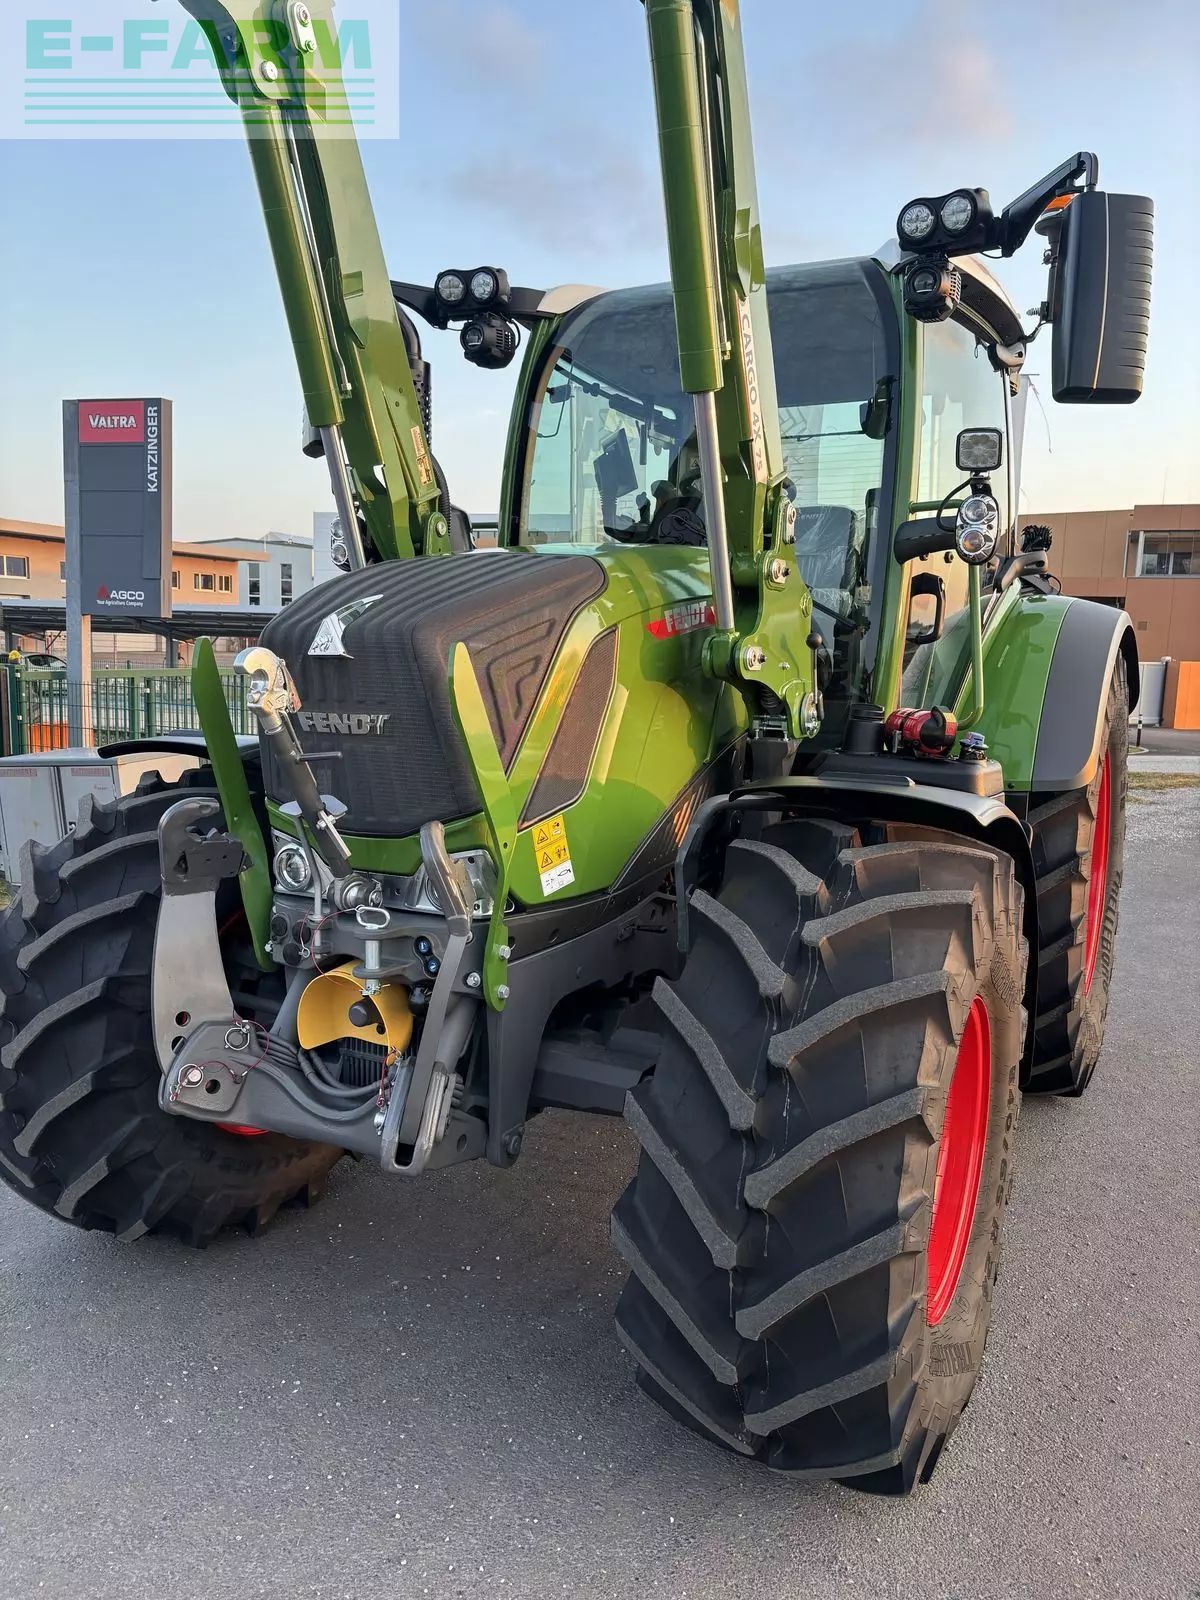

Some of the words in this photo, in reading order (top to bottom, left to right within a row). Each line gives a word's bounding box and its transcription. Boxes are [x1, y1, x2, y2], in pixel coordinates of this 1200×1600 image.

[741, 313, 758, 406] CARGO
[88, 414, 137, 429] VALTRA
[147, 405, 158, 493] KATZINGER
[110, 590, 145, 600] AGCO
[664, 600, 707, 633] FENDT
[297, 711, 391, 735] FENDT
